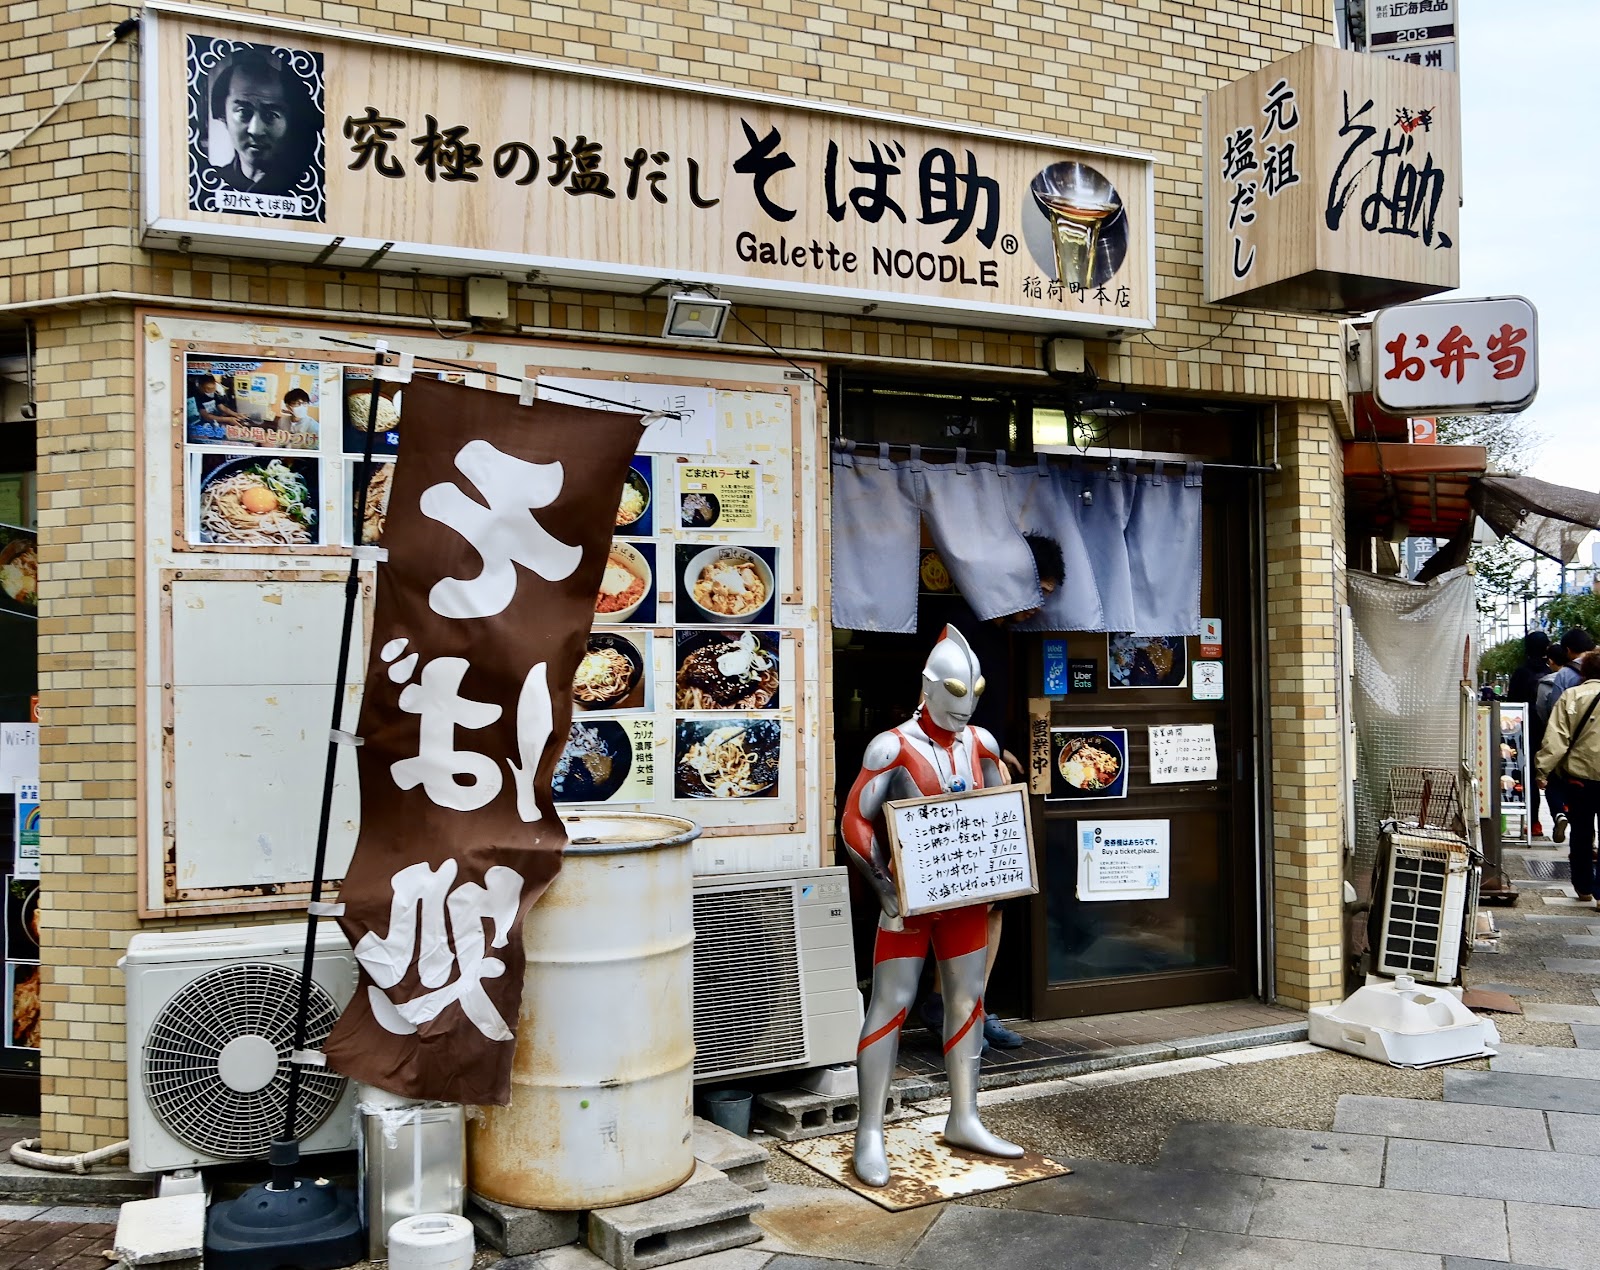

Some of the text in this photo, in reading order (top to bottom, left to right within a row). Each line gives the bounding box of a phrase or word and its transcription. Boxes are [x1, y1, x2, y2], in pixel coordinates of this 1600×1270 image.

[1389, 0, 1448, 18] 近海食品
[1397, 28, 1429, 43] 203
[1262, 79, 1299, 198] 元祖
[343, 106, 1001, 247] 究極の塩だし そば助
[222, 193, 296, 214] 初代そば助
[1223, 129, 1257, 280] 塩だし
[736, 231, 999, 288] Galette NOODLE
[1023, 275, 1131, 309] 稲荷町本店
[1385, 323, 1528, 385] お弁当
[685, 468, 750, 479] ごまだれラーそば
[1073, 671, 1092, 680] Uber
[1073, 680, 1092, 688] Eats
[5, 730, 36, 747] Wi-Fi
[635, 741, 653, 751] 濃厚
[1032, 719, 1049, 775] 営業中
[636, 752, 654, 763] 相性
[636, 764, 654, 775] 女性
[636, 776, 654, 785] 一品
[1101, 848, 1114, 856] Buy
